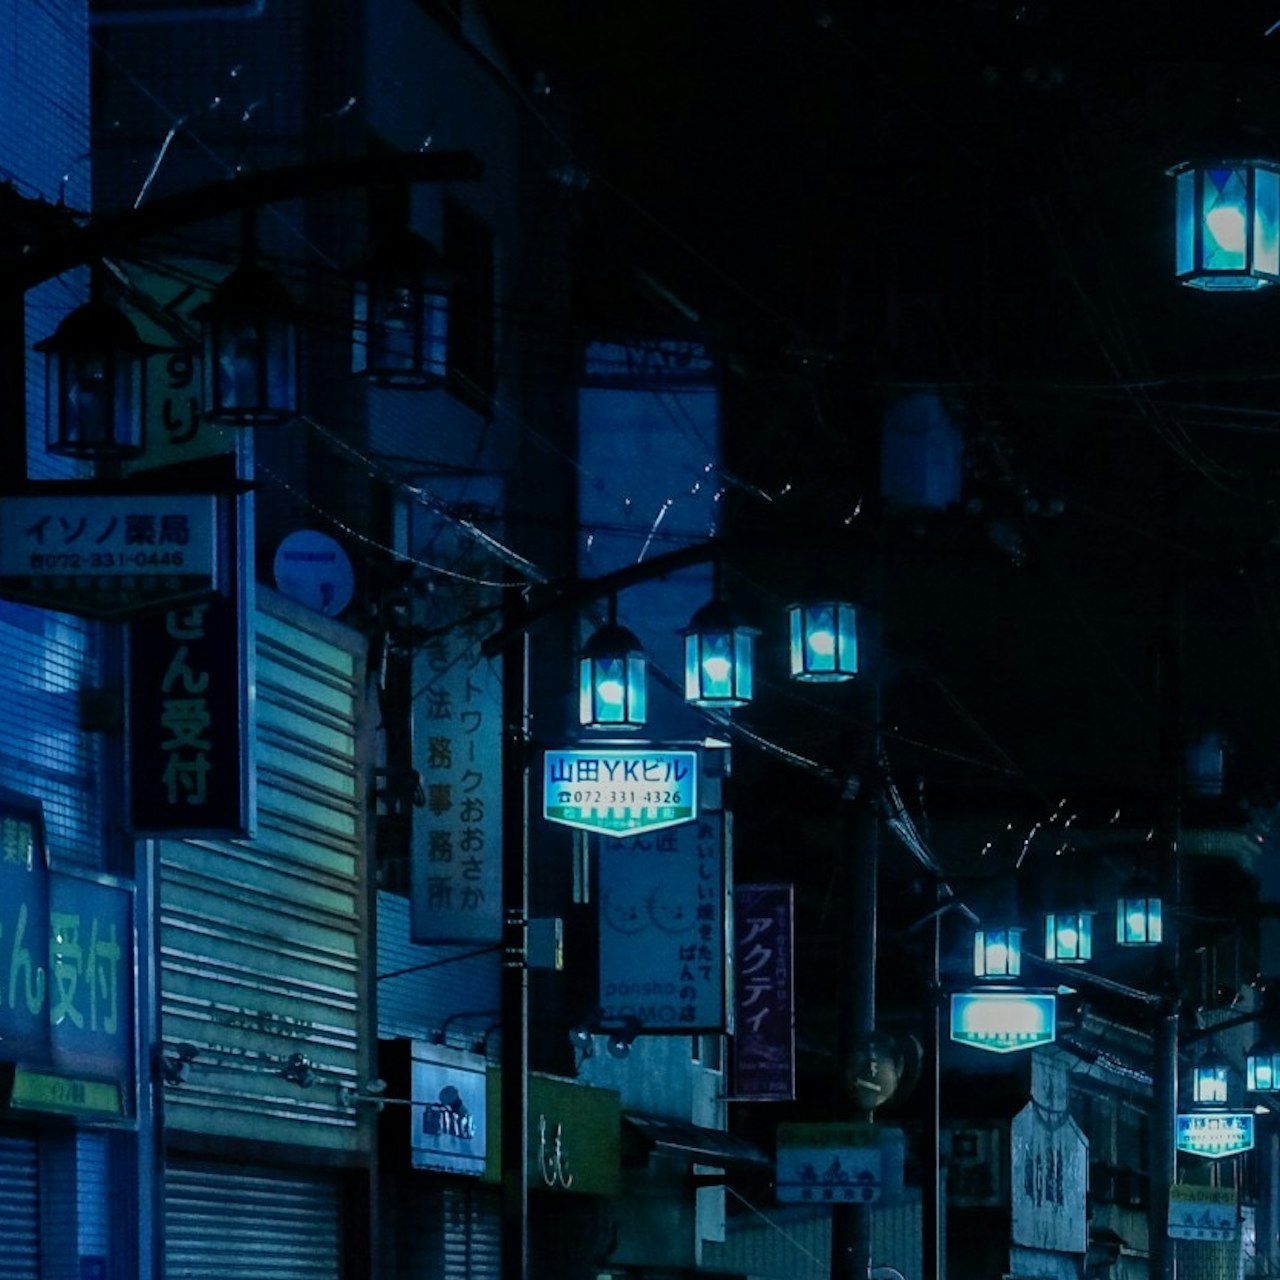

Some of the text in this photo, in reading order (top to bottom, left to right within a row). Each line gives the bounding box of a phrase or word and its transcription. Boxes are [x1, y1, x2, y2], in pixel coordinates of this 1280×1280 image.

[24, 514, 191, 546] イソノ薬局
[551, 758, 687, 783] 山田YKビル
